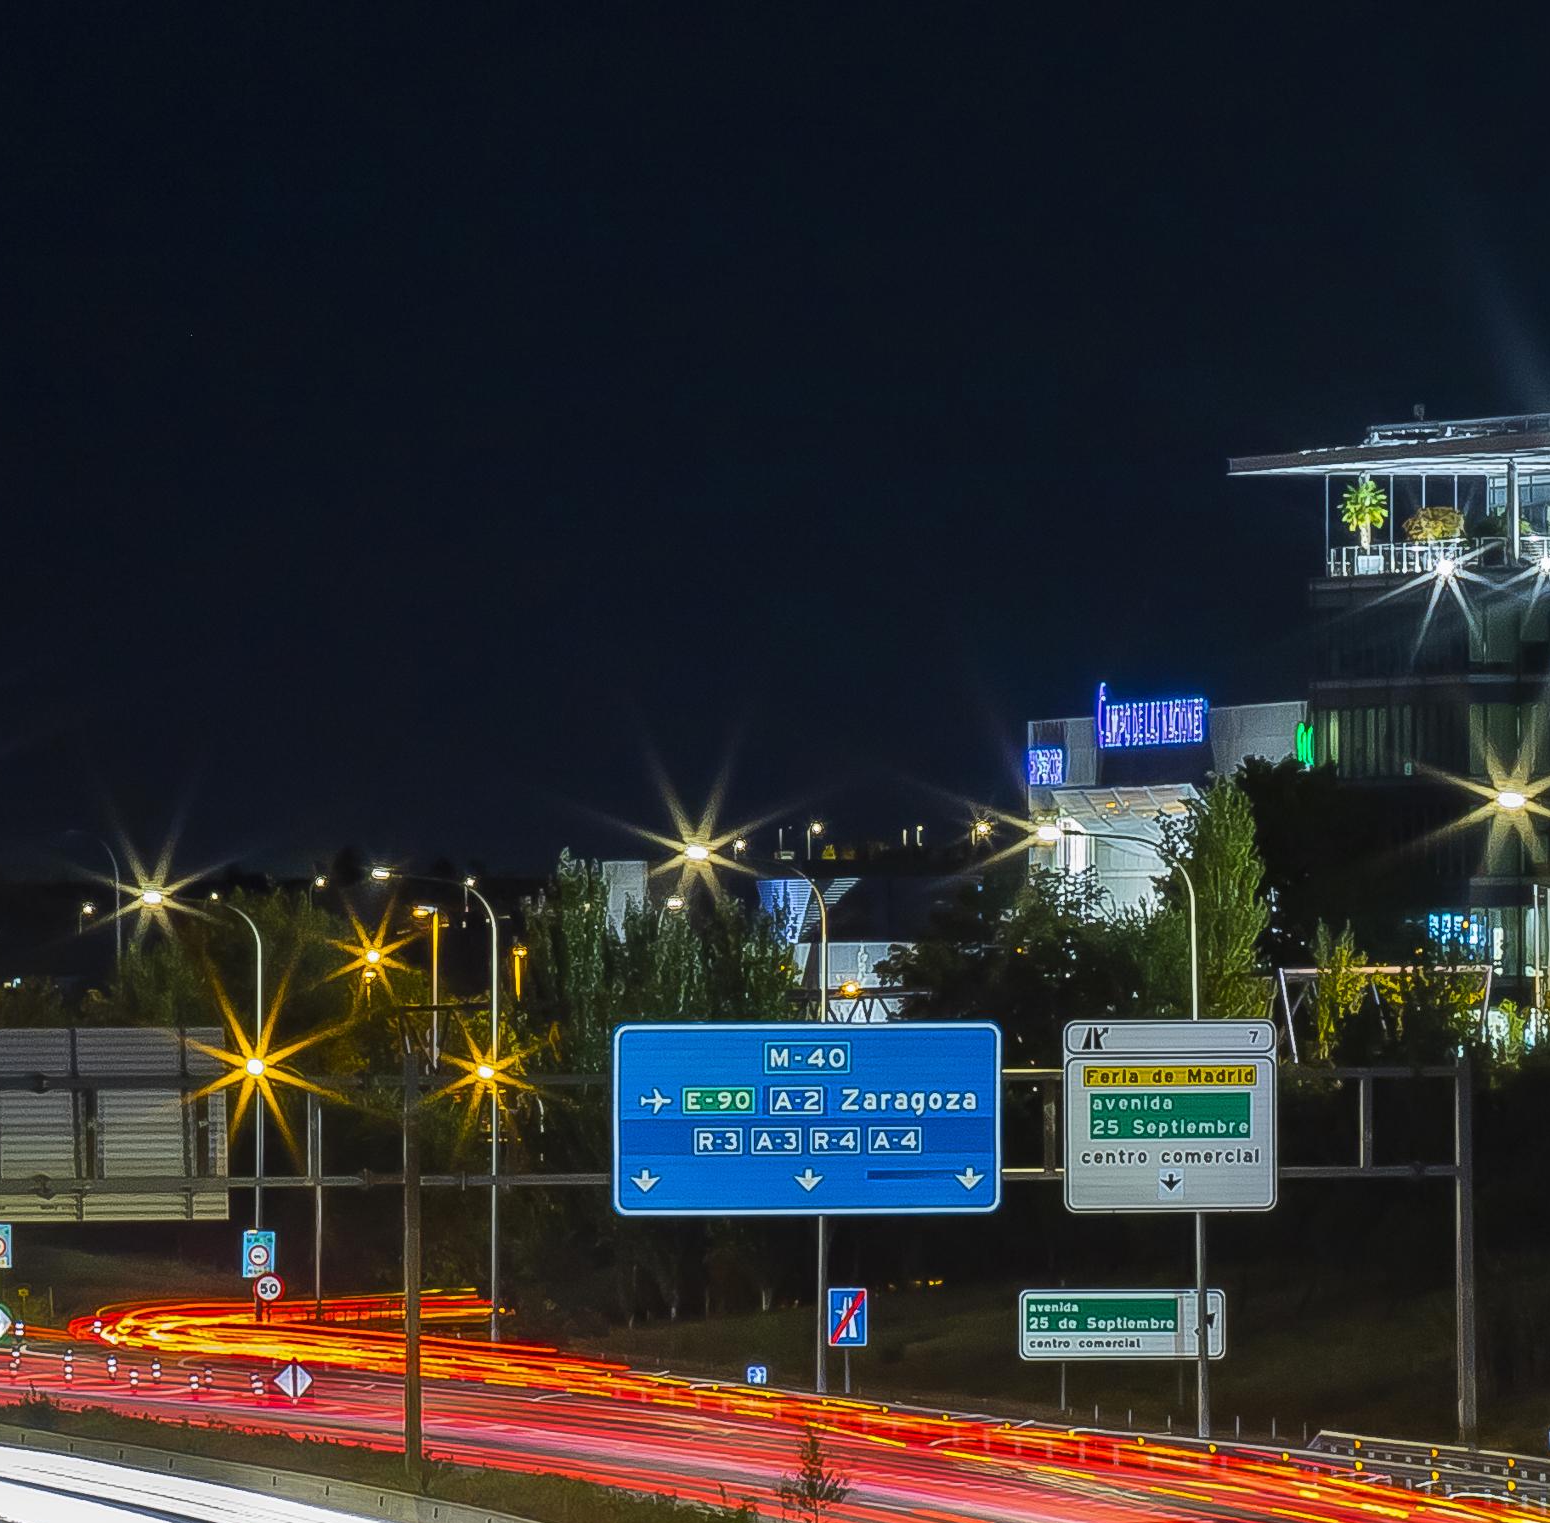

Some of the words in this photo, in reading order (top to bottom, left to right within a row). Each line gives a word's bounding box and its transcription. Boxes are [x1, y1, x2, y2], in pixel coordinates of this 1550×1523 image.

[1248, 1030, 1259, 1044] 7
[769, 1047, 847, 1069] M-40
[1086, 1069, 1139, 1084] Feria
[1152, 1068, 1174, 1084] de
[1187, 1068, 1255, 1083] Madrid
[686, 1091, 751, 1111] E-90
[773, 1090, 821, 1111] A-2
[840, 1088, 977, 1116] Zaragoza
[1092, 1095, 1173, 1111] avenida
[1092, 1119, 1120, 1135] 25
[1132, 1118, 1249, 1137] Septiembre
[698, 1131, 739, 1151] R-3
[755, 1131, 798, 1151] A-3
[813, 1130, 856, 1150] R-4
[873, 1129, 917, 1149] A-4
[1080, 1150, 1148, 1165] centro
[1160, 1147, 1260, 1164] comercial
[260, 1282, 278, 1295] 50
[1029, 1301, 1079, 1313] avenida
[1029, 1316, 1049, 1330] 25
[1058, 1316, 1078, 1330] de
[1086, 1316, 1175, 1332] Septiembre
[1029, 1338, 1071, 1349] centro
[1078, 1337, 1141, 1349] comercial
